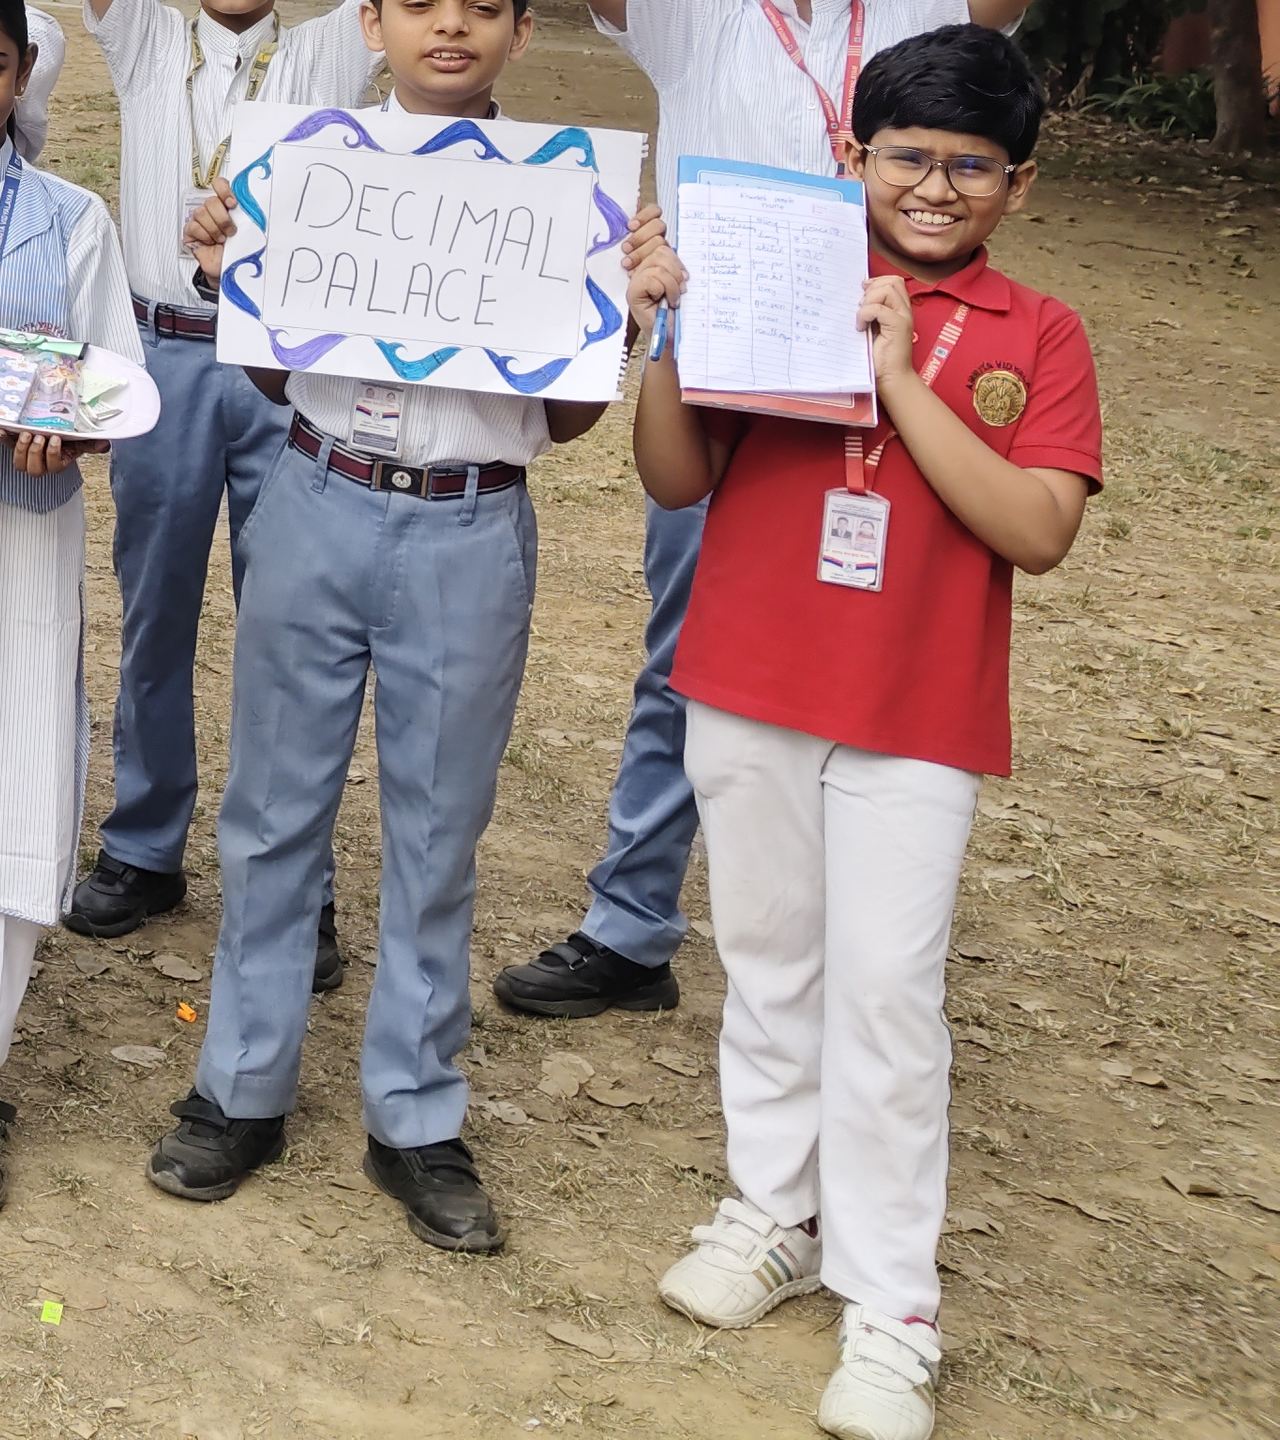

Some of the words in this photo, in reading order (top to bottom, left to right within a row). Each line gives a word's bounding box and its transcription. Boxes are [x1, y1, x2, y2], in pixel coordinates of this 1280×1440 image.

[0, 188, 14, 225] VIDYALAYAM
[294, 162, 569, 283] DECIMAL
[281, 247, 497, 326] PALACE
[966, 361, 993, 390] AMRITA
